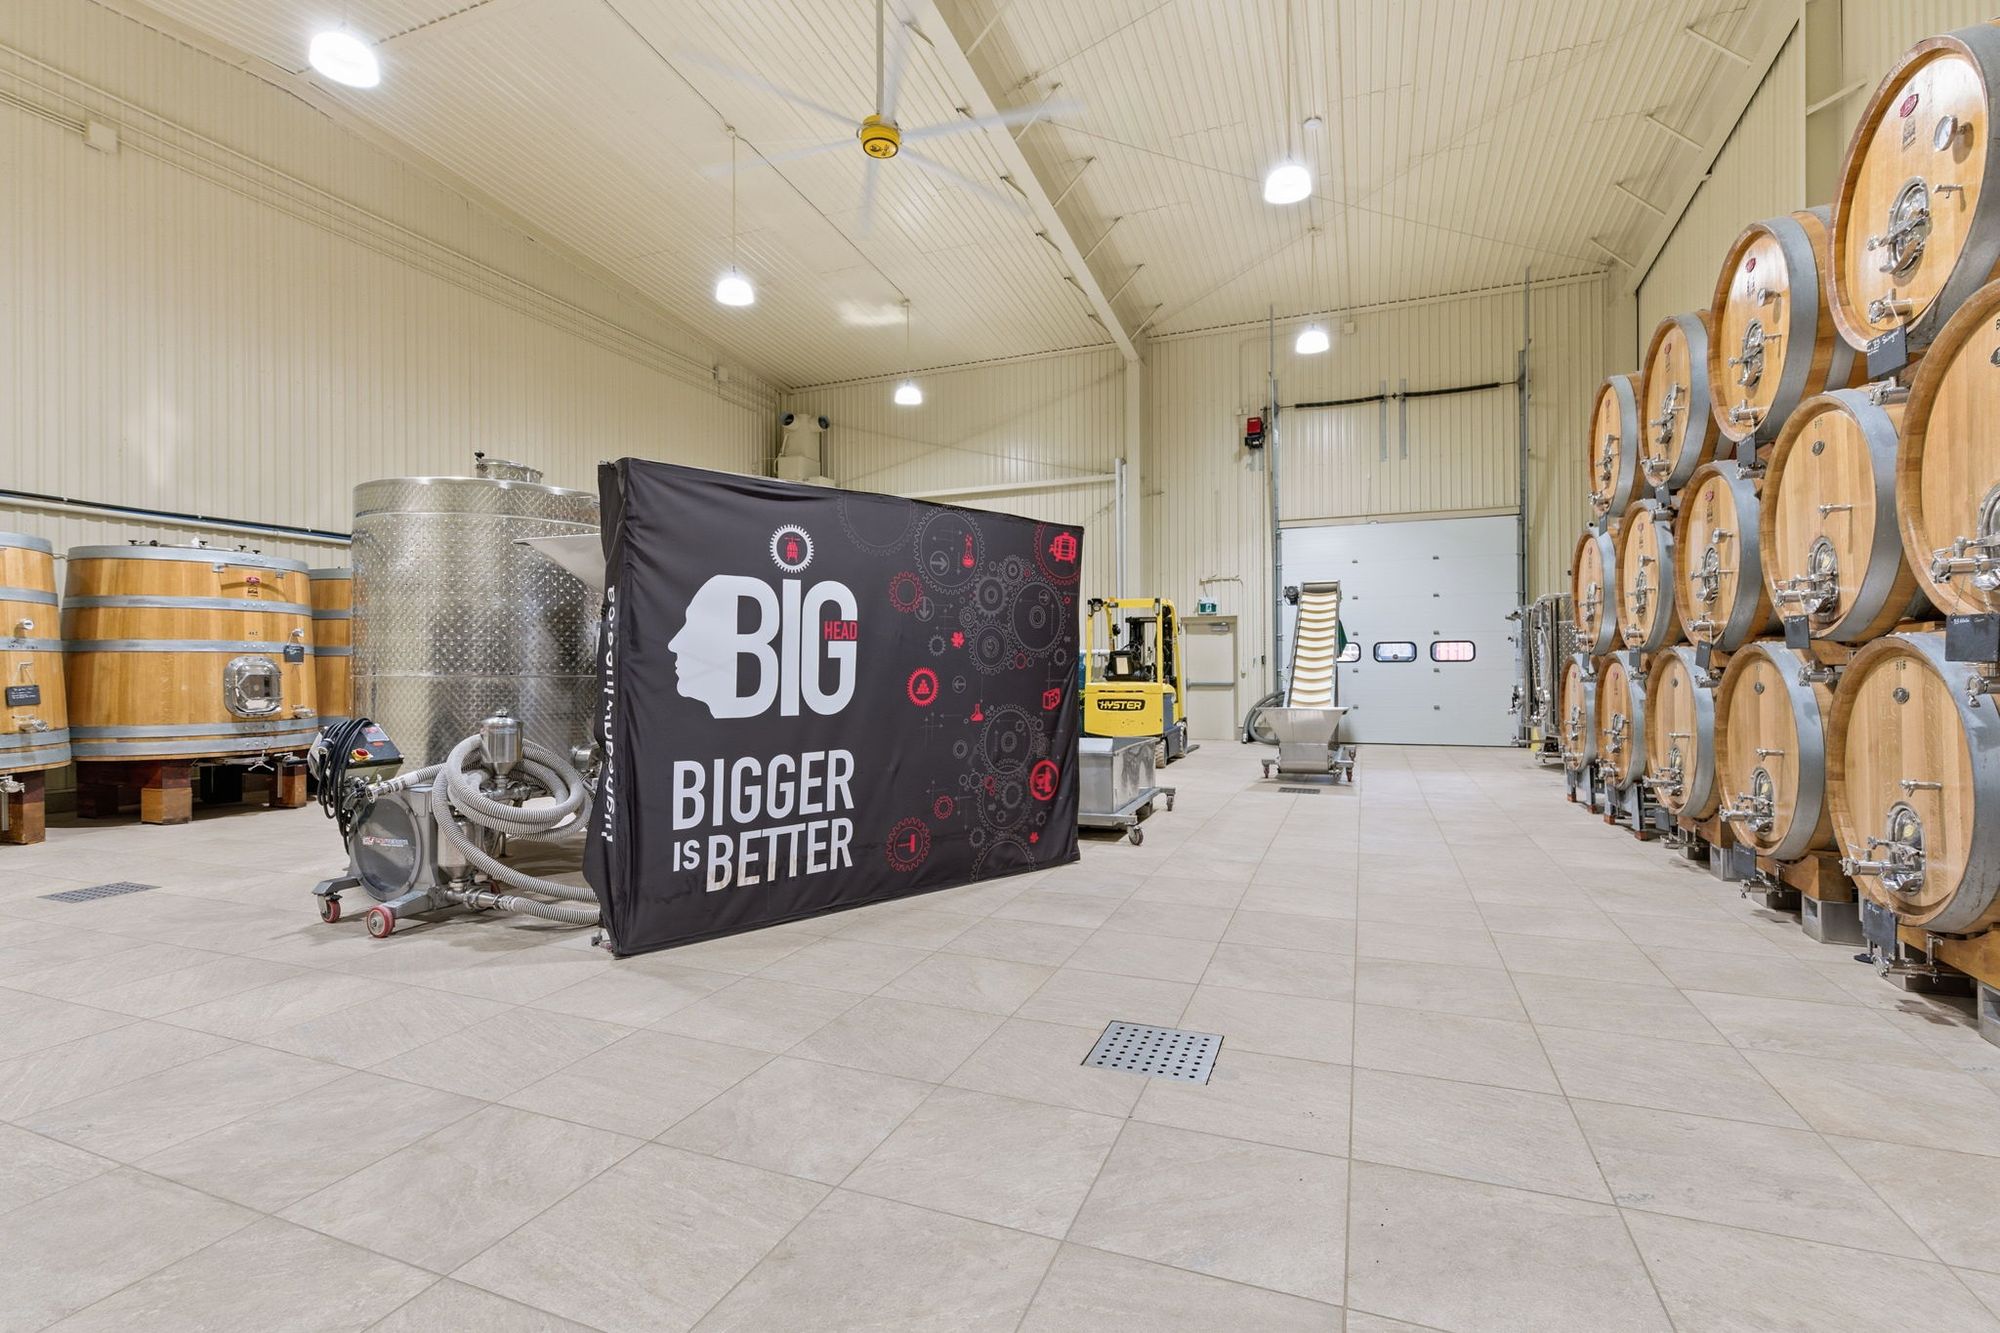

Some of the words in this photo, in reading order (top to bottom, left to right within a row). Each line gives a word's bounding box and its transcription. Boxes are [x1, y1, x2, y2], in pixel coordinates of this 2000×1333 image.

[667, 574, 858, 719] BIG
[823, 620, 858, 640] HEAD
[1098, 700, 1142, 710] HYSTER
[673, 749, 855, 831] BIGGER
[673, 839, 701, 873] IS
[706, 817, 854, 893] BETTER
